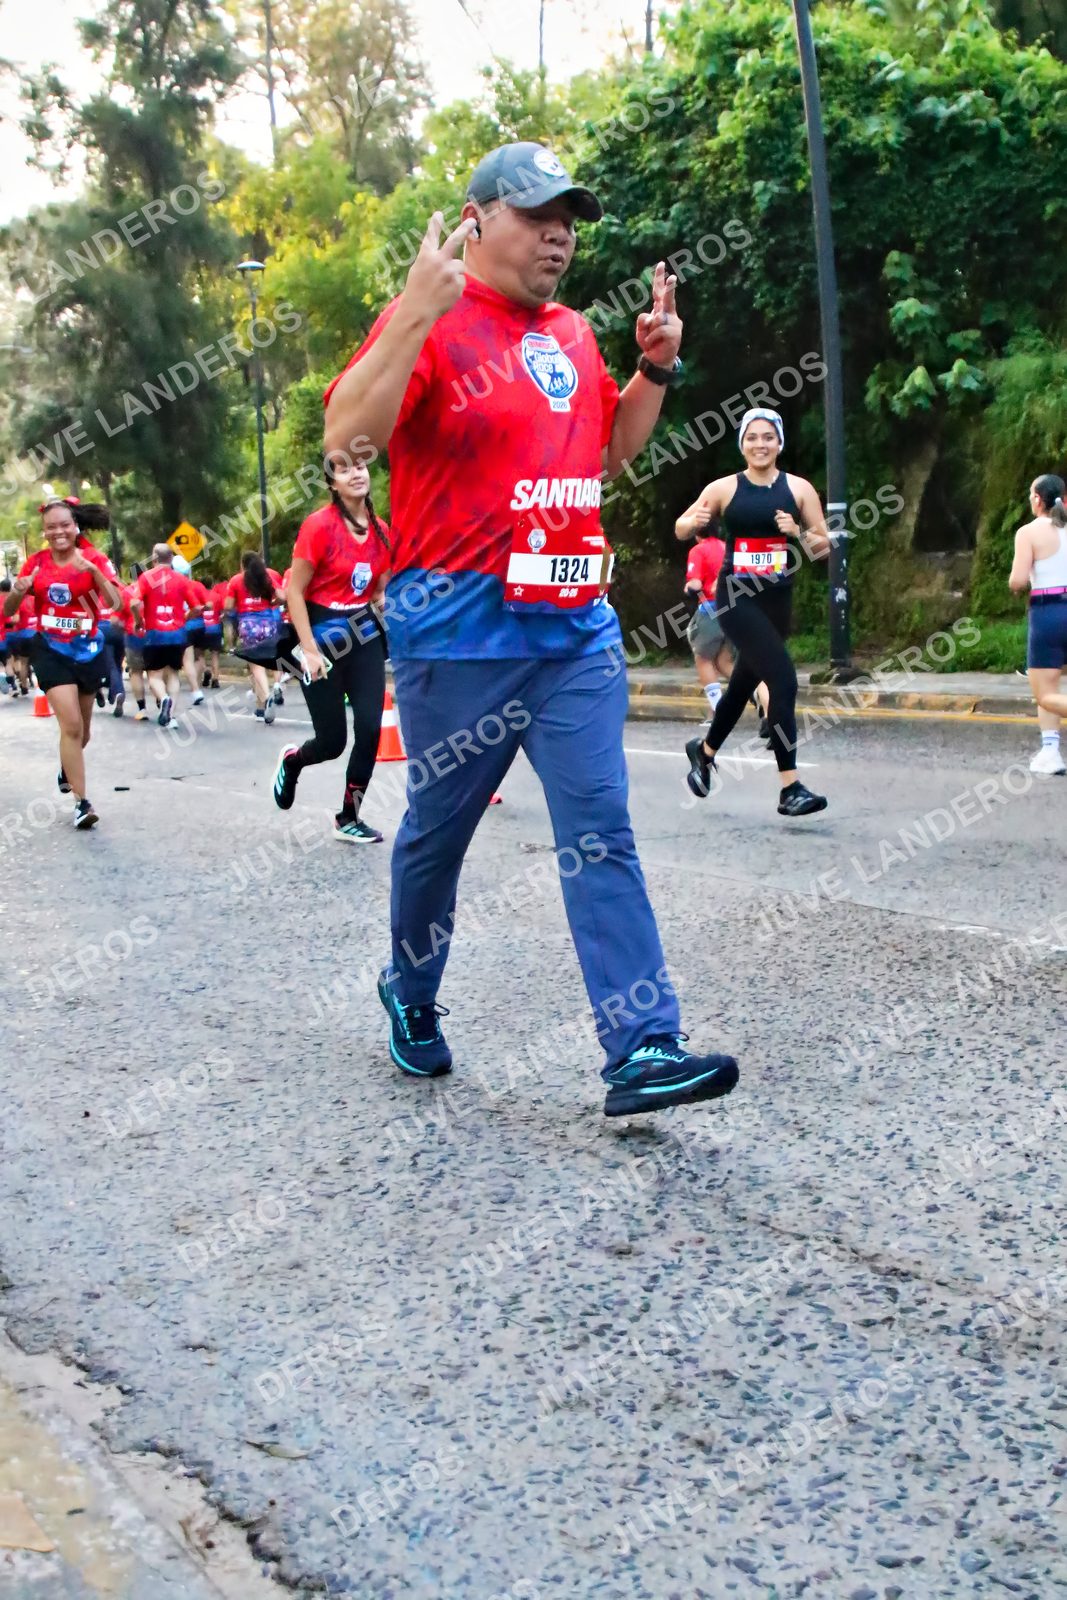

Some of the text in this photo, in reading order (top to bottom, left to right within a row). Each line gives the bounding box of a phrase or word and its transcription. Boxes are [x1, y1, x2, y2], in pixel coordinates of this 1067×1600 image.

[534, 351, 559, 364] Global
[533, 361, 553, 373] Race
[510, 478, 602, 511] SANTIAG
[751, 553, 773, 565] 1970
[550, 557, 590, 583] 1324
